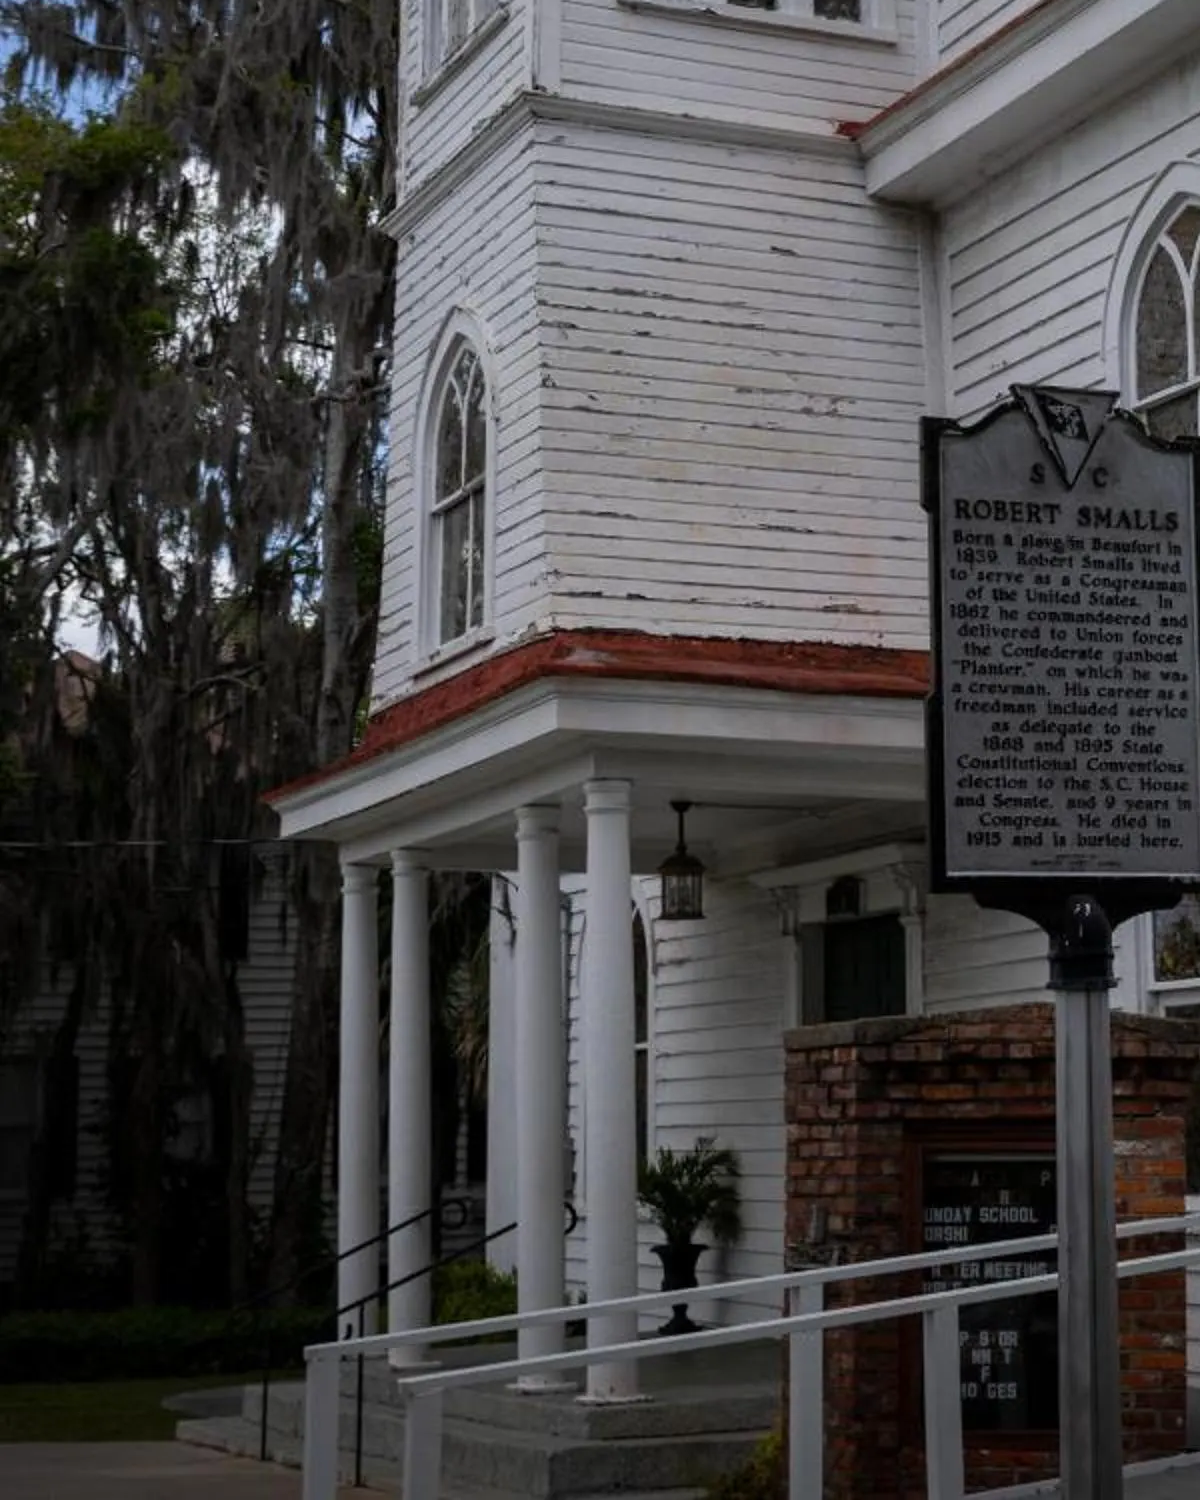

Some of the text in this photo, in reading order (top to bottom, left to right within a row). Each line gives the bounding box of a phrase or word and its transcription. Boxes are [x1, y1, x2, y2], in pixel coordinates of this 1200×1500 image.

[1029, 464, 1109, 487] S C
[954, 499, 1179, 531] ROBERT SMALLS
[953, 530, 1182, 555] Born a slave in Beaufort in
[1017, 552, 1073, 568] Robert
[1082, 555, 1133, 571] Smalls
[1142, 558, 1181, 574] lived
[950, 568, 1187, 593] to serve as a Congressman
[966, 586, 983, 599] of
[992, 587, 1017, 601] the
[1025, 588, 1081, 605] United
[1158, 594, 1173, 609] In
[949, 603, 1188, 628] 1862 he commandeered and
[957, 624, 1183, 645] delivered to Union forces
[964, 642, 1178, 664] the Confederate gunboat
[1046, 666, 1066, 677] on
[1075, 664, 1122, 680] which
[1133, 667, 1150, 681] he
[1160, 671, 1188, 682] was
[951, 682, 1188, 701] a crewman. His career as a
[954, 699, 1188, 718] freedman included service
[991, 719, 1156, 738] as delegate to the
[983, 736, 1164, 754] 1868 and 1895 State
[957, 754, 1077, 771] Constitutional
[957, 775, 1027, 789] election
[1037, 776, 1054, 789] to
[1064, 776, 1090, 791] the
[1139, 778, 1189, 792] House
[954, 794, 985, 807] and
[1066, 796, 1096, 810] and
[1104, 796, 1116, 809] 9
[1125, 799, 1169, 811] years
[1177, 797, 1192, 811] in
[1078, 815, 1101, 828] He
[1111, 815, 1147, 828] died
[1157, 815, 1171, 828] in
[966, 832, 1183, 849] 1915 and is buried here.
[979, 1207, 1039, 1223] SCHOOL
[983, 1261, 1048, 1279] MEETING
